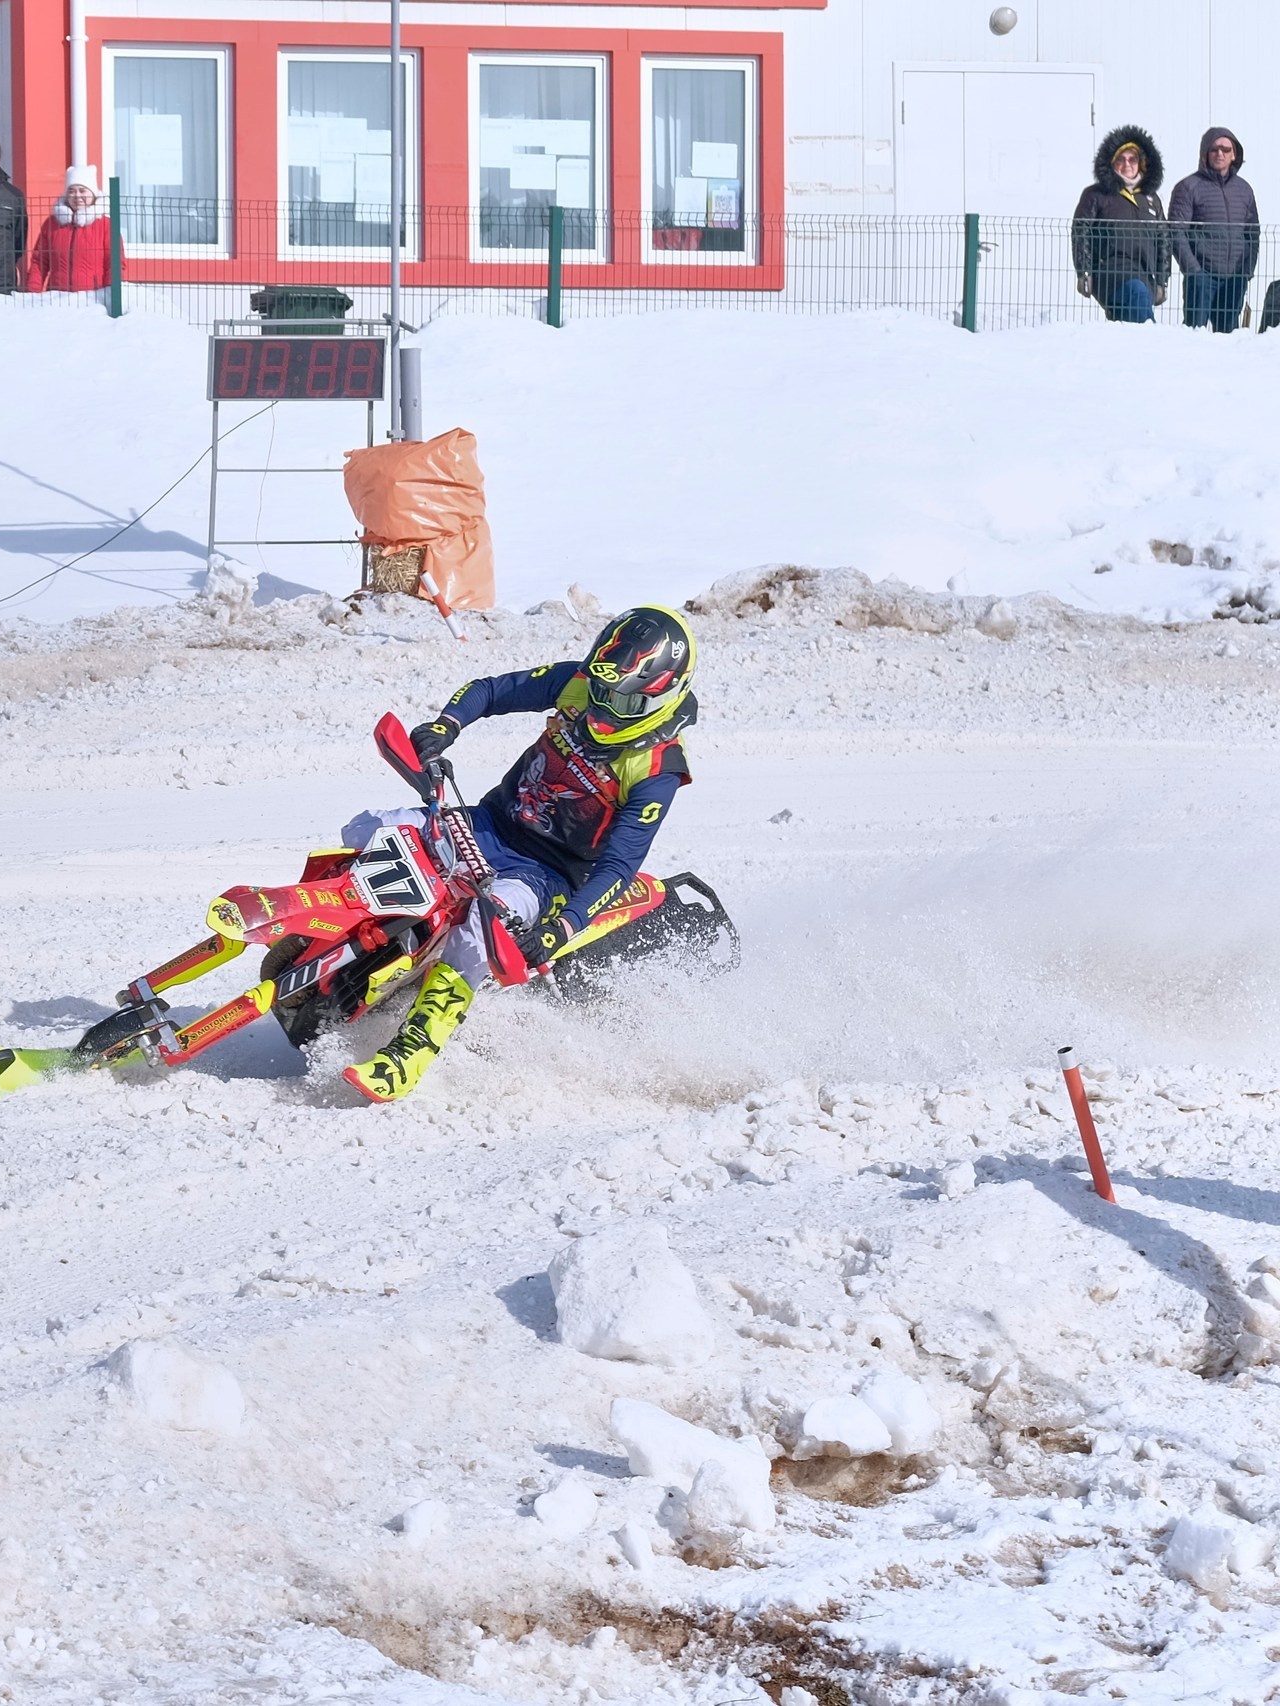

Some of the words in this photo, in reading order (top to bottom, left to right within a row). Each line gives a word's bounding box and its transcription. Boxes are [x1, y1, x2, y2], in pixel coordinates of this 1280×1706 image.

[356, 835, 429, 908] 717
[445, 814, 483, 879] RENTHAL
[587, 878, 622, 918] SCOTT
[318, 921, 342, 932] SCOTT
